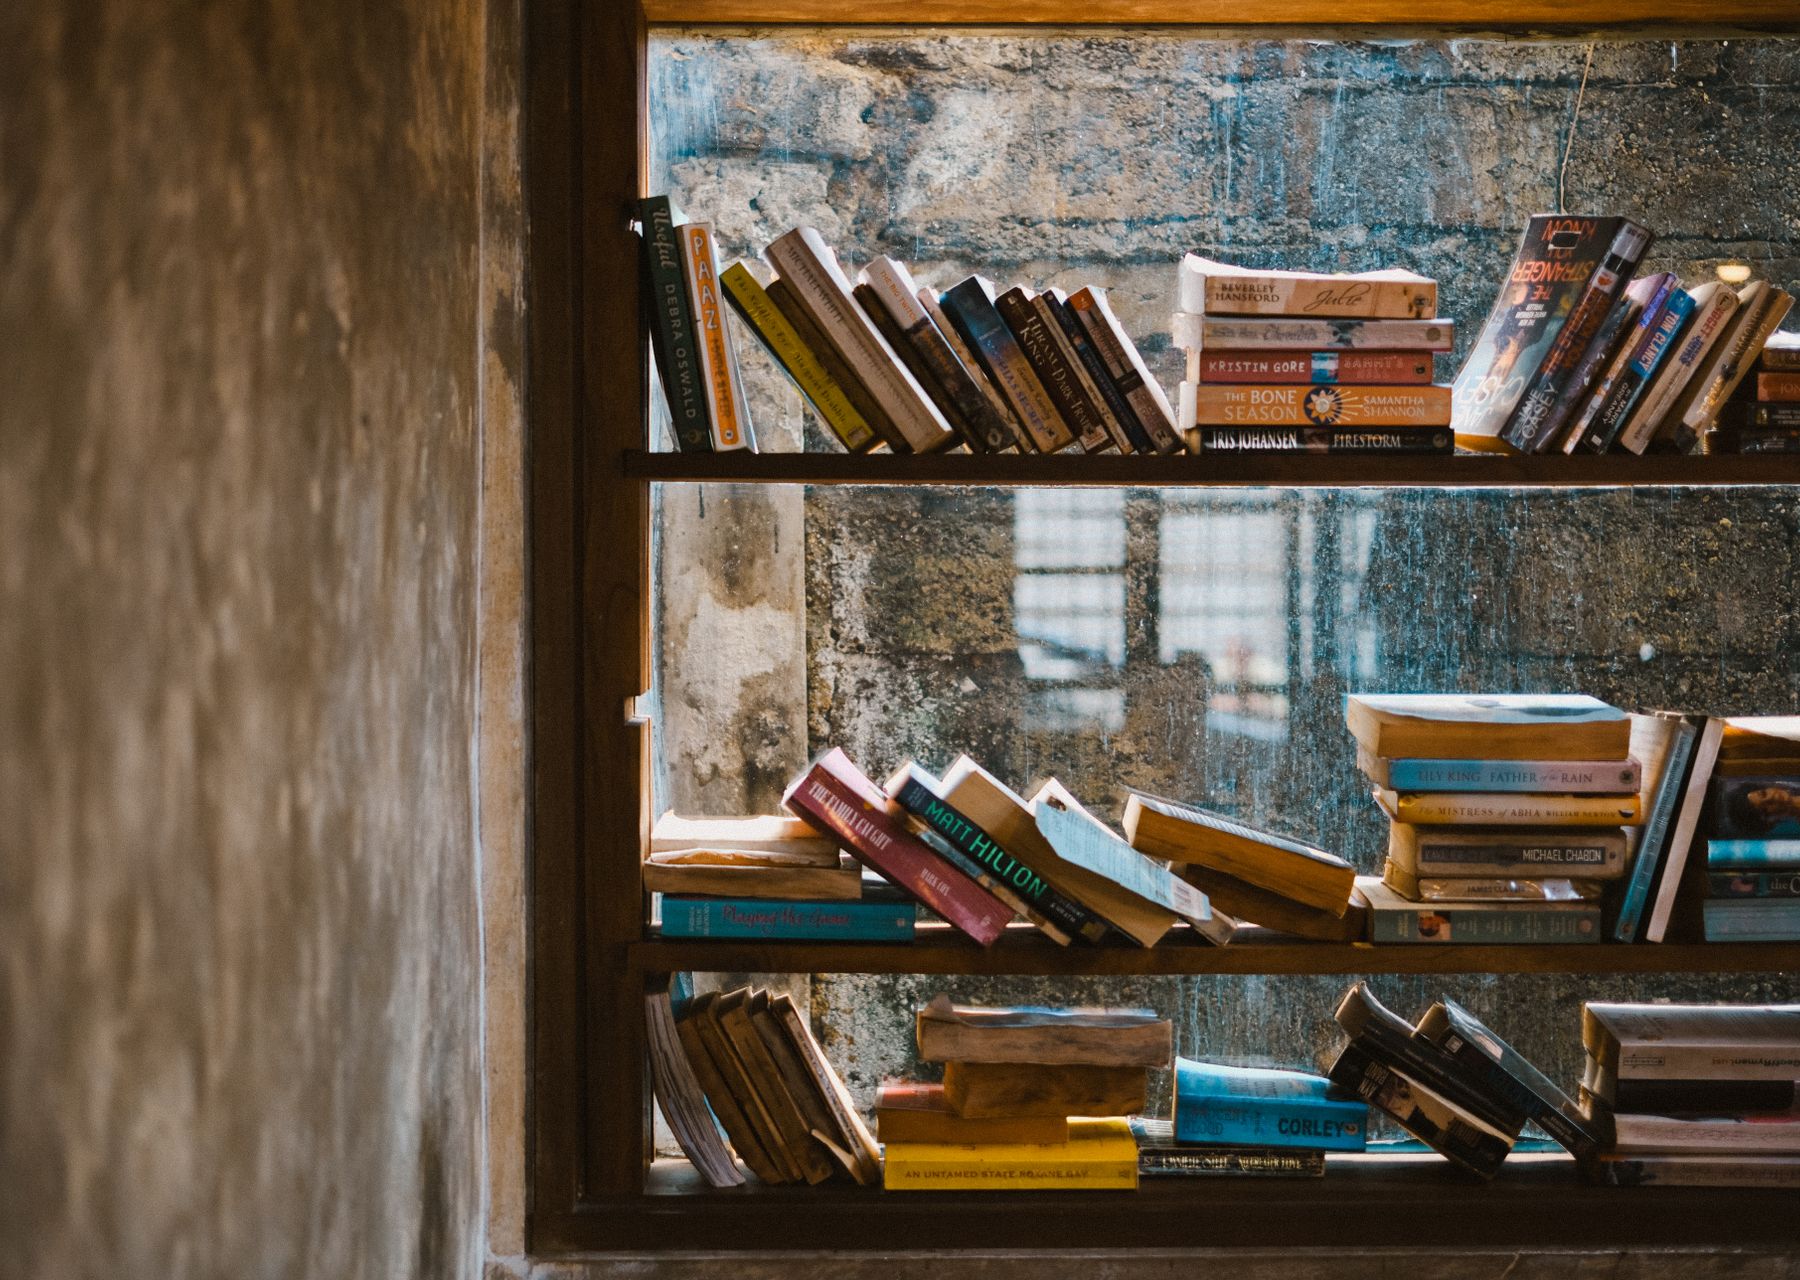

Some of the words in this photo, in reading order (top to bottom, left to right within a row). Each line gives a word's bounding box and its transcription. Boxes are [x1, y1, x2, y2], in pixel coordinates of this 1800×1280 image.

[652, 208, 676, 270] Useful
[1512, 260, 1594, 282] STRANGER
[1215, 293, 1280, 303] HANSFORD
[1221, 283, 1276, 294] BEVERLEY
[1303, 282, 1371, 312] Julie
[1532, 284, 1554, 300] THE
[1660, 310, 1679, 332] TOM
[663, 283, 684, 340] DEBRA
[674, 347, 697, 418] OSWALD
[1018, 327, 1047, 366] KING
[1637, 331, 1667, 371] CLANCY
[1209, 361, 1268, 372] KRISTIN
[1274, 362, 1305, 373] GORE
[1052, 368, 1077, 400] DARK
[1225, 392, 1246, 401] THE
[1250, 389, 1297, 405] BONE
[1363, 396, 1424, 406] SAMANTHA
[1601, 383, 1629, 423] GREANEY
[1224, 406, 1297, 421] SEASON
[1363, 406, 1424, 417] SHANNON
[1521, 384, 1557, 439] CASEY
[1609, 400, 1627, 425] MARK
[1212, 430, 1236, 449] IRIS
[1238, 428, 1298, 454] JOHANSEN
[1333, 433, 1400, 449] FIRESTORM
[1418, 771, 1442, 782] LILY
[1448, 772, 1480, 783] KING
[1490, 771, 1538, 784] FATHER
[1561, 772, 1593, 783] RAIN
[807, 781, 830, 801] THE
[824, 794, 859, 824] FAMILY
[1438, 807, 1493, 817] MISTRESS
[1510, 808, 1540, 817] ABHA
[926, 802, 970, 842] MATT
[968, 833, 1048, 897] HILTON
[1522, 849, 1563, 862] MICHAEL
[1566, 850, 1601, 862] CHABON
[1278, 1117, 1345, 1138] CORLEY
[905, 1170, 921, 1179] AN
[924, 1170, 979, 1179] UNTAMED
[981, 1170, 1016, 1179] STATE
